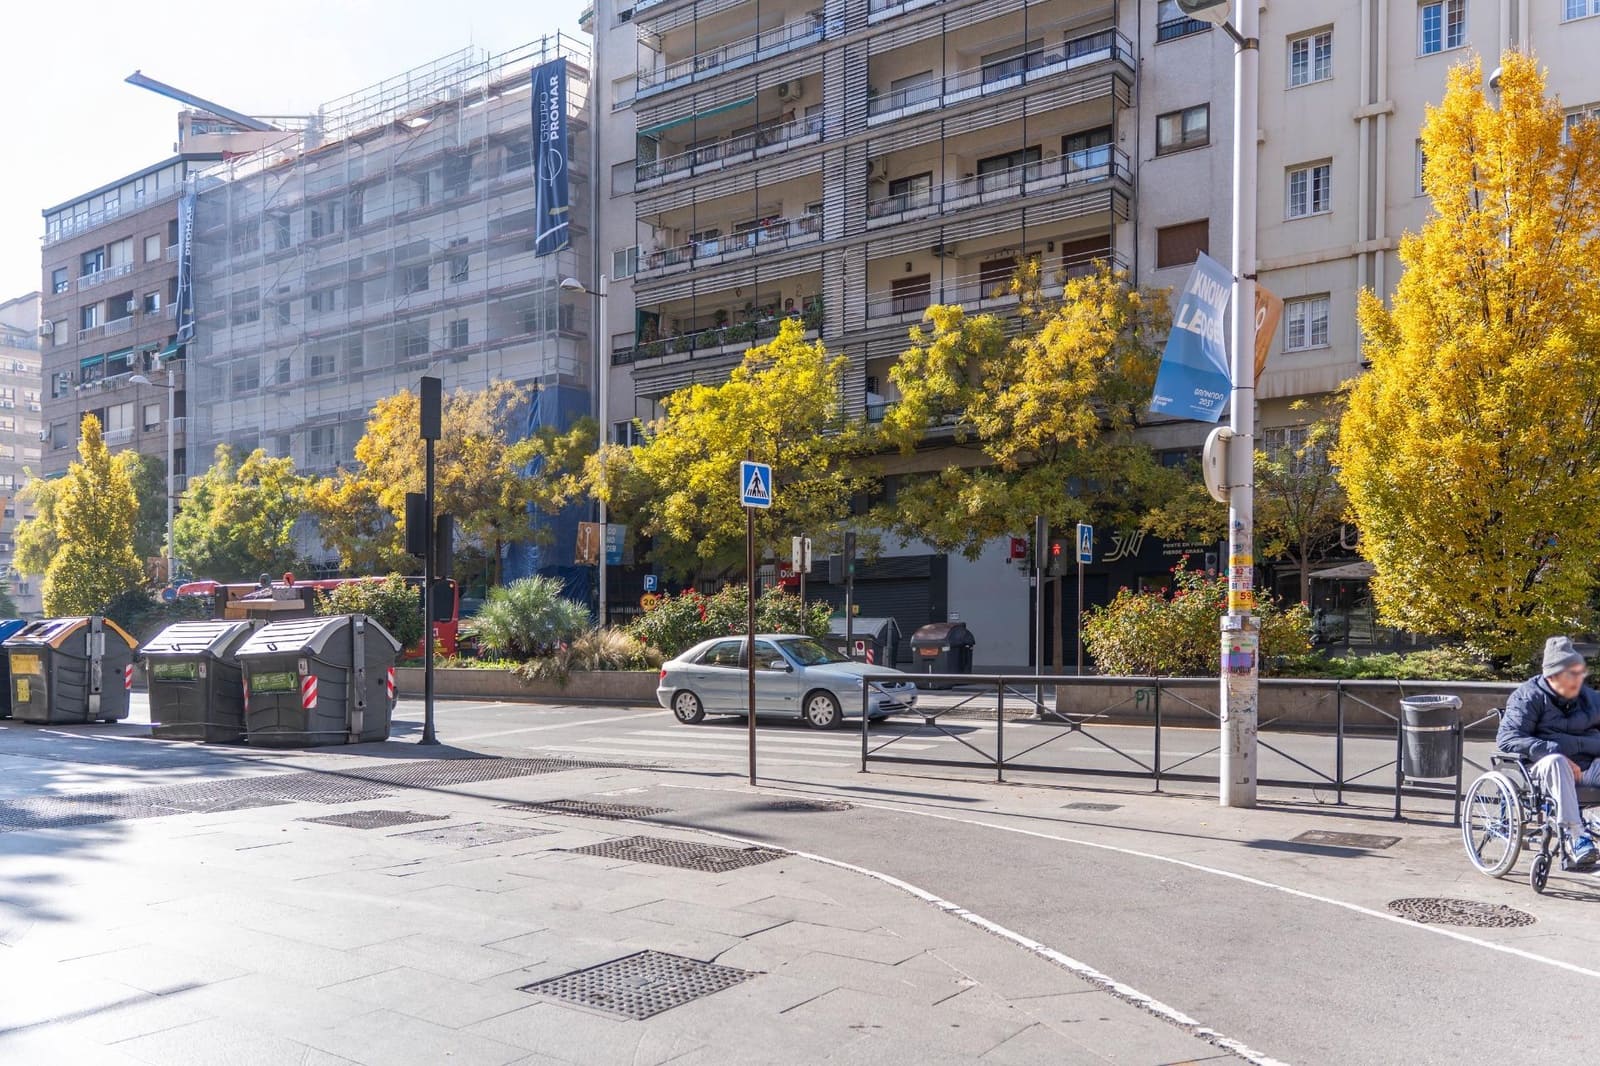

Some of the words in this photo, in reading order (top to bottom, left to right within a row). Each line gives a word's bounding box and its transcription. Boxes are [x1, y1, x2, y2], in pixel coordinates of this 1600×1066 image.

[540, 91, 550, 143] GRUPO
[550, 75, 560, 141] PROMAR
[1190, 271, 1231, 313] KNOW
[646, 576, 654, 589] P
